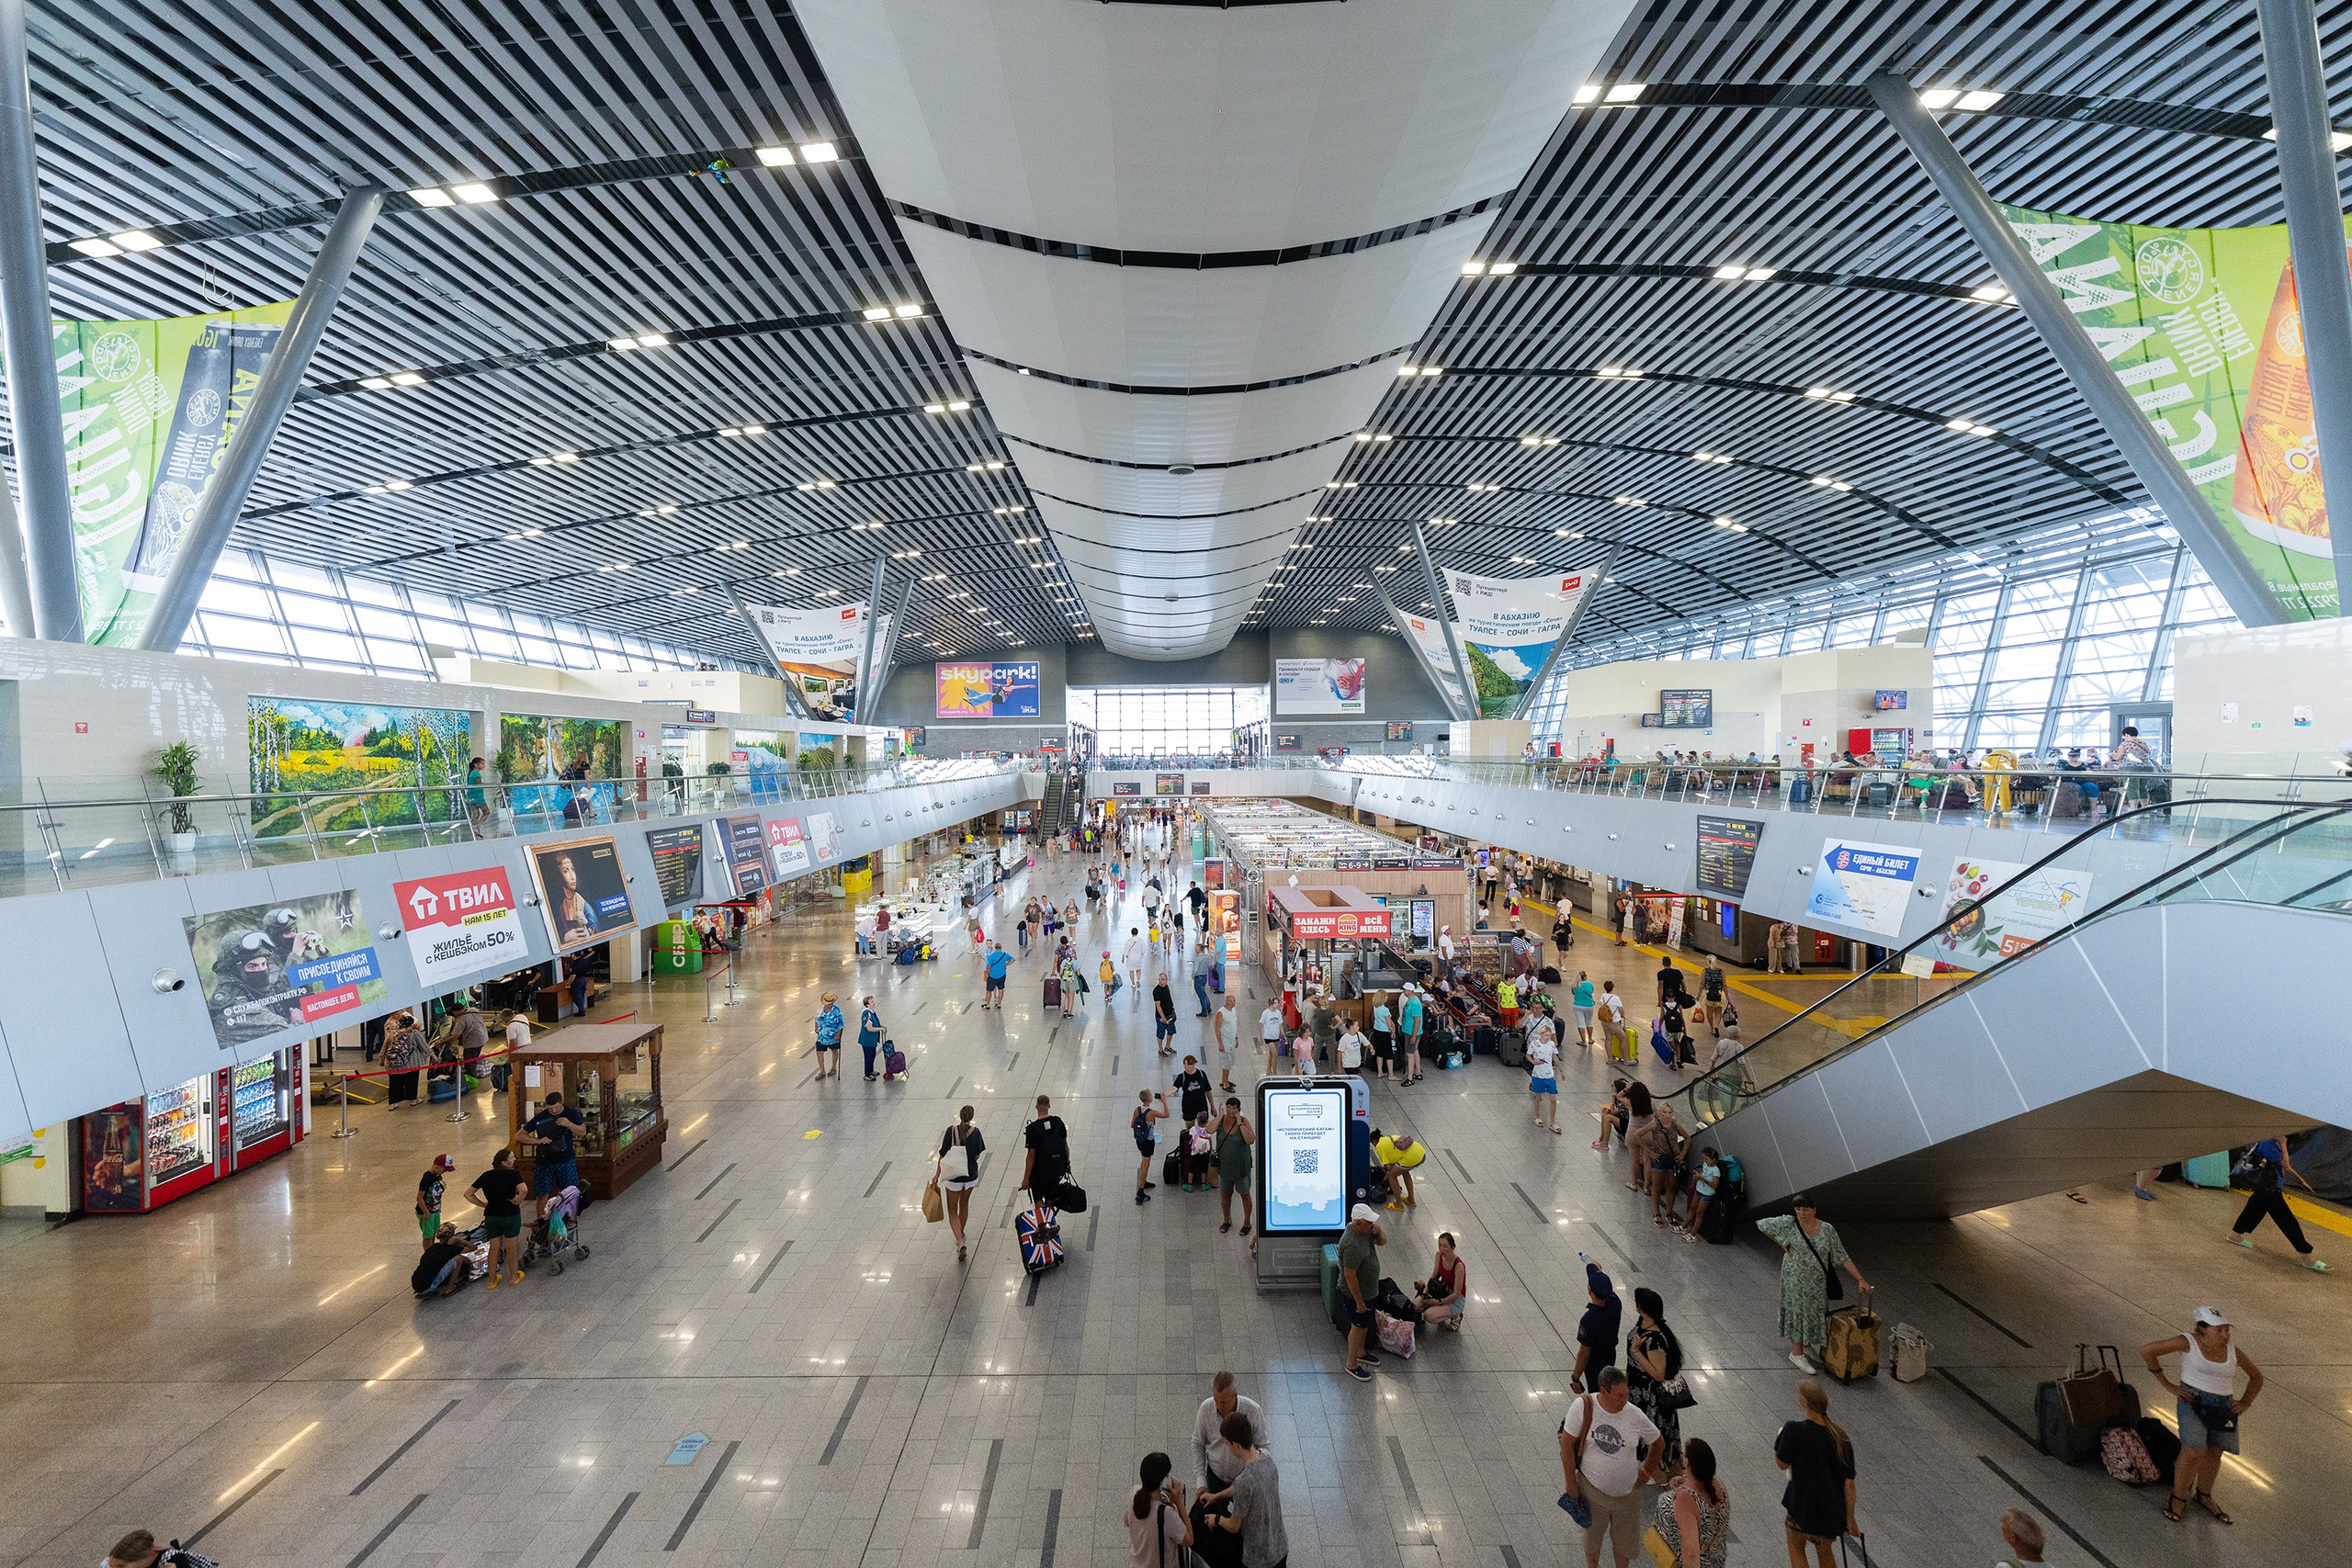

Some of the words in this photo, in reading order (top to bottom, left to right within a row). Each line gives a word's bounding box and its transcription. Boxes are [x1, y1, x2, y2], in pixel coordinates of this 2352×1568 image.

[1476, 619, 1520, 628] туристическом
[1500, 612, 1541, 621] АБХАЗИЮ
[1468, 625, 1498, 636] ТУАПСЕ
[1507, 628, 1529, 637] СОЧИ
[1537, 623, 1561, 634] ГАГРА
[800, 634, 833, 642] АБХАЗИЮ
[776, 646, 801, 655] ТУАПСЕ
[808, 648, 827, 656] СОЧИ
[833, 643, 854, 653] ГАГРА
[940, 666, 1037, 683] skypark!
[780, 825, 800, 839] ТВИЛ
[1852, 854, 1883, 866] ЕДИНЫЙ
[1884, 858, 1910, 870] БИЛЕТ
[443, 882, 504, 911] ТВИЛ
[464, 915, 482, 926] НАМ
[482, 912, 492, 921] 15
[492, 909, 507, 920] ЛЕТ
[1295, 917, 1336, 925] ЗАКАЖИ
[1364, 915, 1383, 925] ВСЁ
[1300, 925, 1330, 934] ЗДЕСЬ
[1359, 925, 1387, 933] МЕНЮ
[433, 933, 472, 953] ЖИЛЬЁ
[486, 931, 514, 947] 50%
[673, 924, 685, 967] СБЕР
[2002, 939, 2014, 953] 5
[298, 953, 368, 981] ПРИСОЕДИНЯЙСЯ
[335, 973, 342, 985] К
[342, 965, 371, 983] СВОИМ
[307, 998, 340, 1012] НАСТОЯЩЕЕ
[340, 992, 355, 1004] ДЕЛО
[236, 1014, 246, 1023] 117
[1590, 1430, 1625, 1448] RELAX
